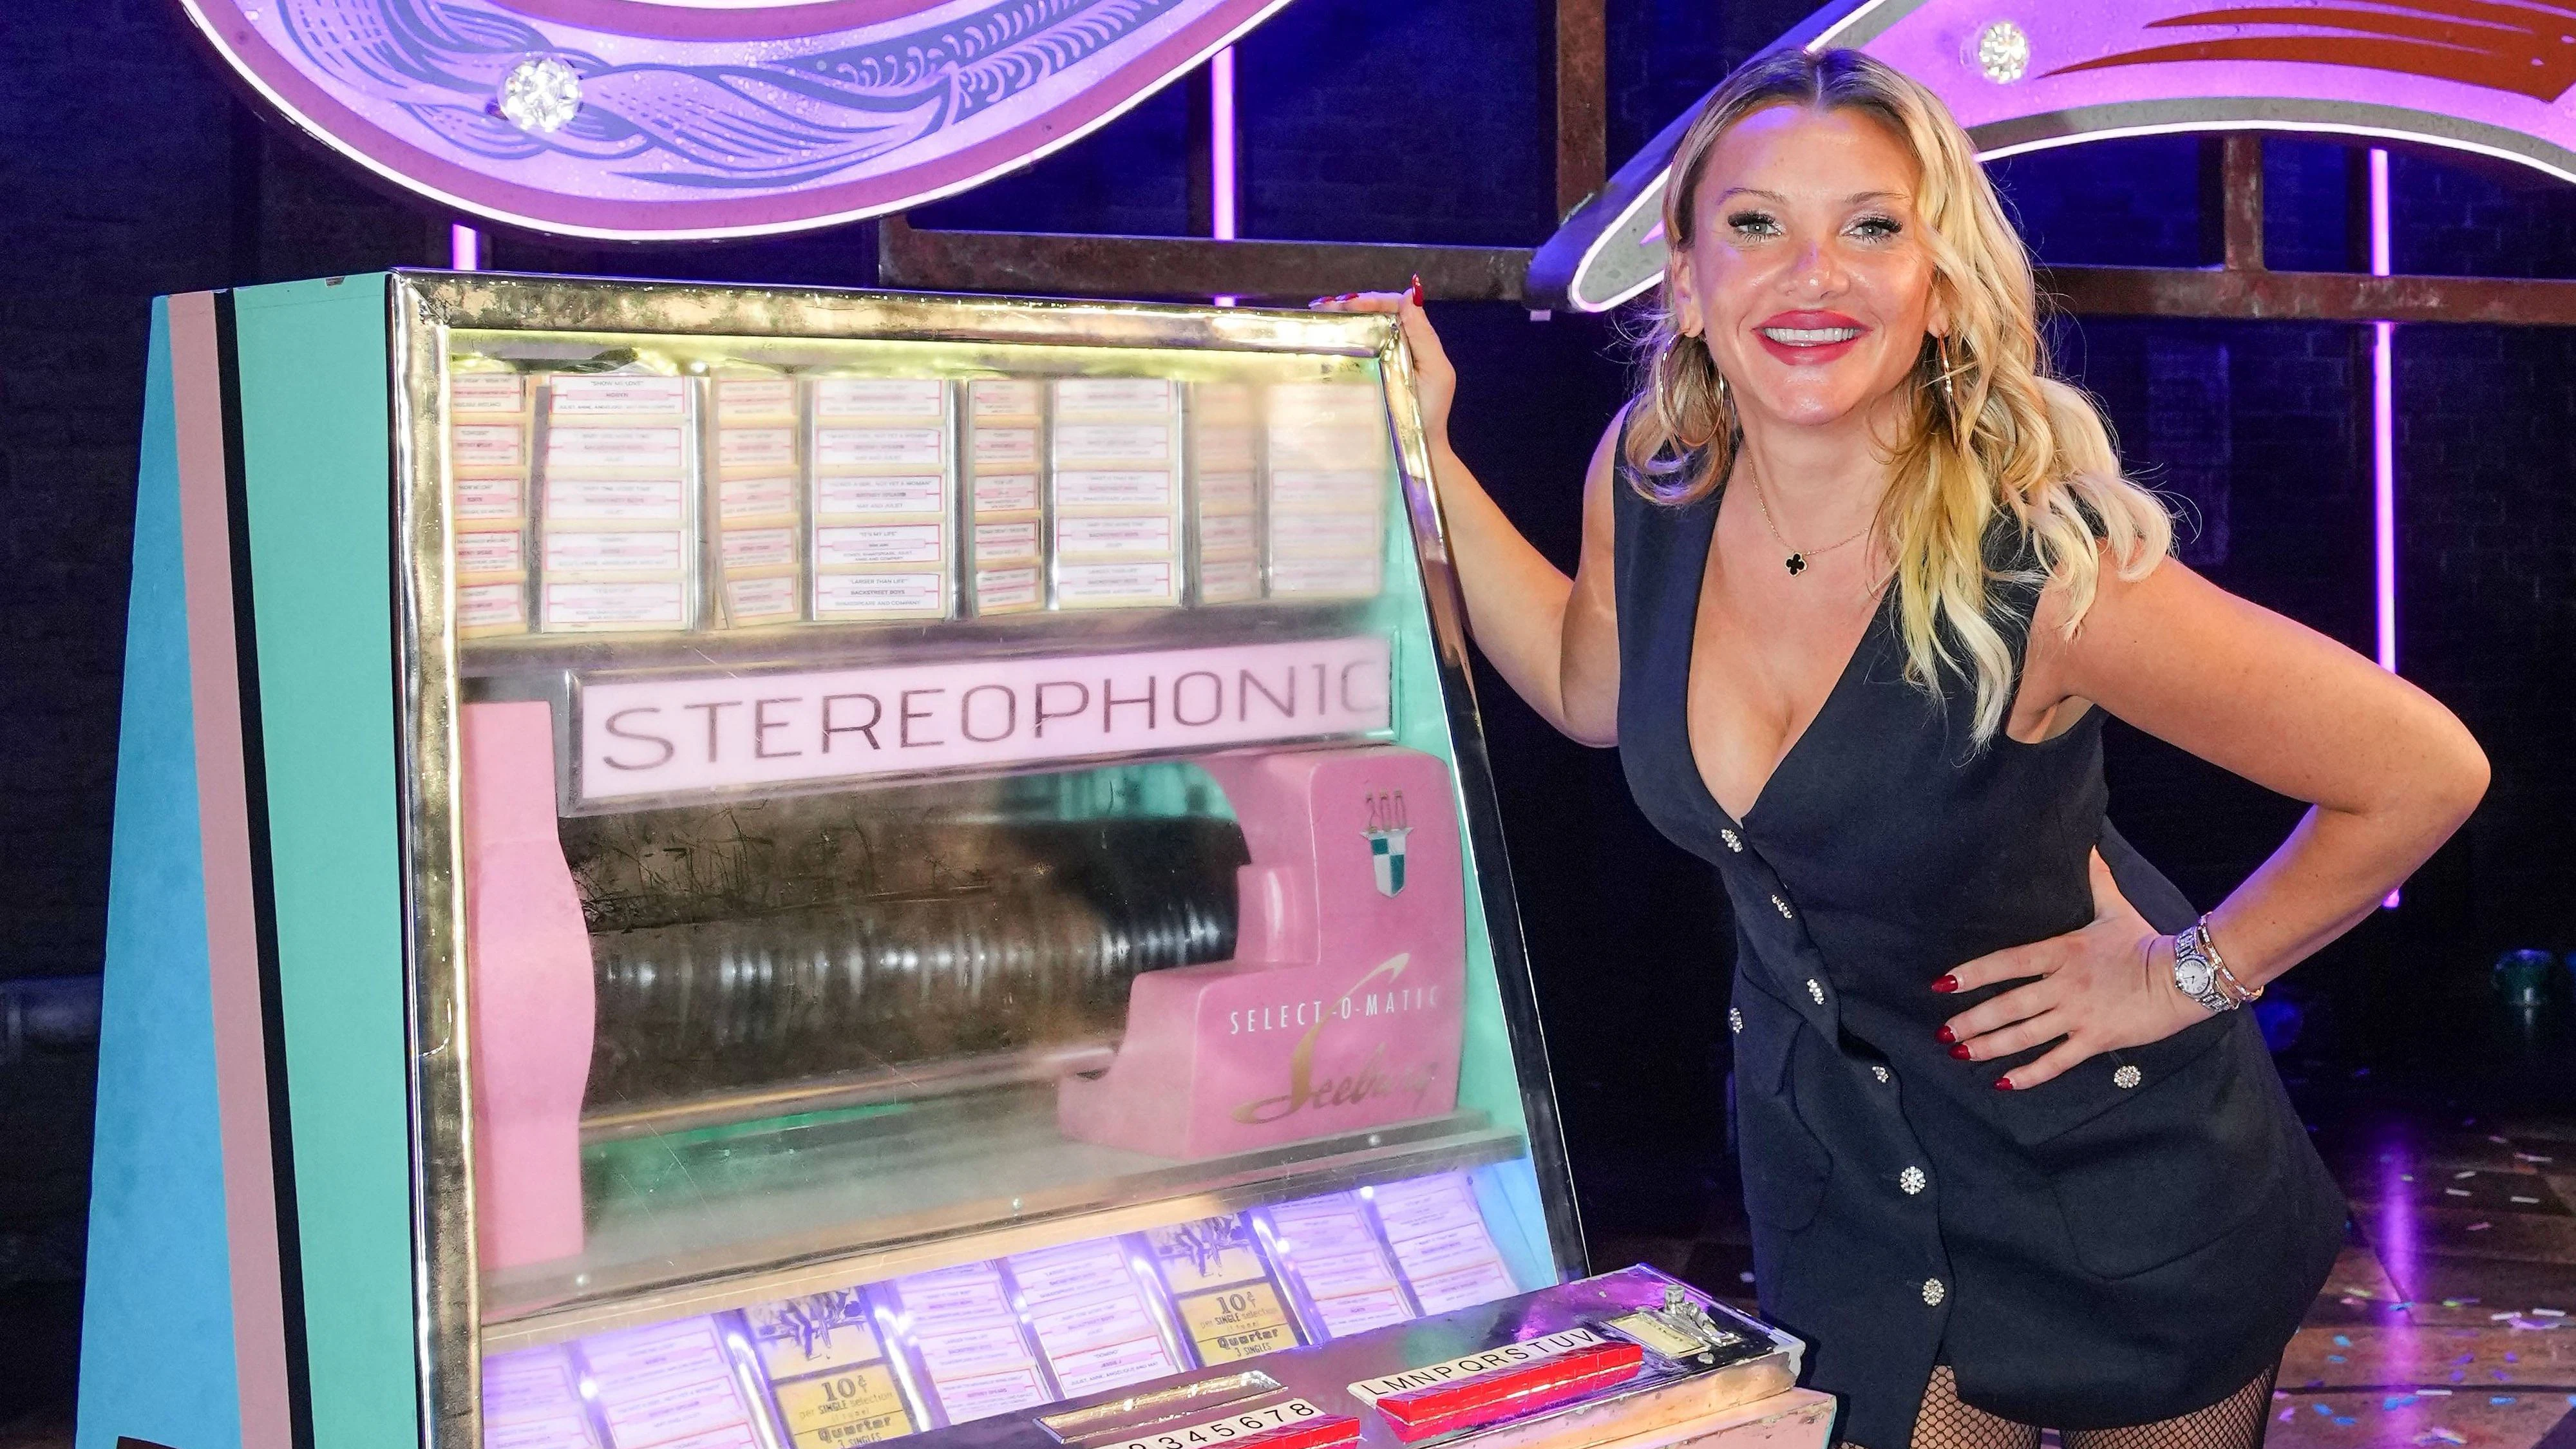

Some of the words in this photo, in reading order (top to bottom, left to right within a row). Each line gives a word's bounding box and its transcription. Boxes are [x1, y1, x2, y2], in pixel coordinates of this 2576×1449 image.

[603, 658, 1381, 773] STEREOPHONIC
[1215, 1312, 1241, 1325] SINGLE
[1217, 1329, 1278, 1350] Quarter
[1235, 1348, 1242, 1358] 3
[1244, 1343, 1272, 1356] SINGLES
[819, 1399, 848, 1415] SINGLE
[818, 1416, 891, 1444] Quarter
[849, 1432, 882, 1446] SINGLES
